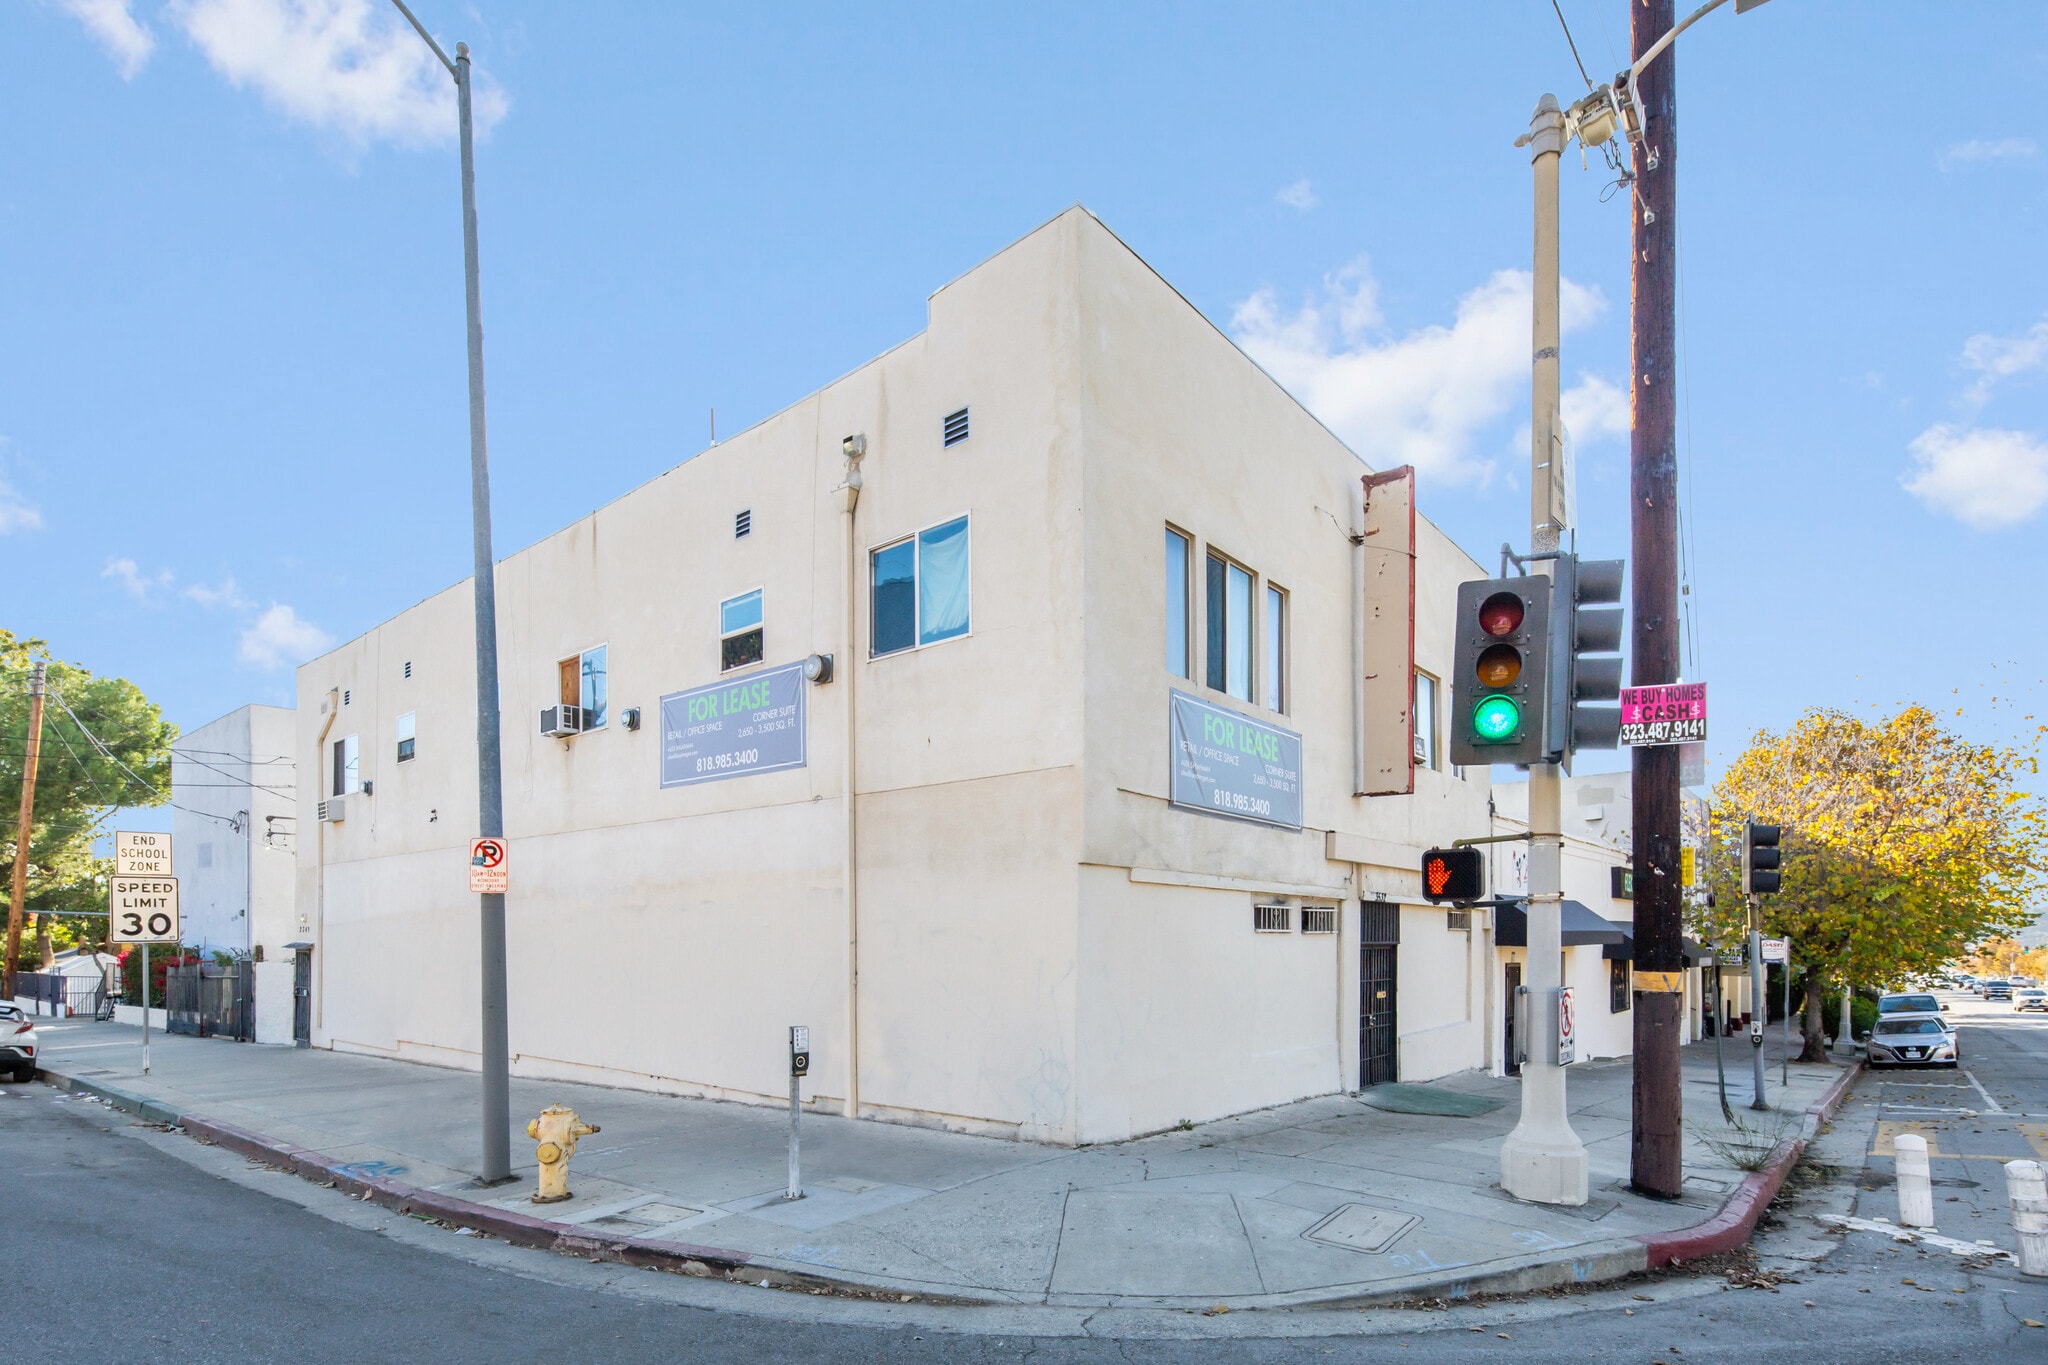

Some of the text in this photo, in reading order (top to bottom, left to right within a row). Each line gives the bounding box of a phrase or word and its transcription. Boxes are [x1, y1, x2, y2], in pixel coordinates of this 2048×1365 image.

[688, 681, 770, 723] FOR LEASE
[1623, 684, 1704, 705] WE BUY HOMES
[753, 705, 796, 722] CORNER SUITE
[1642, 703, 1690, 721] CASH
[667, 730, 682, 740] RETAIL
[687, 725, 705, 736] OFFICE
[706, 721, 723, 733] SPACE
[758, 722, 774, 735] 3,500
[1204, 713, 1278, 762] FOR LEASE
[1622, 718, 1704, 740] 323.487.9141
[696, 748, 758, 772] 818.985.3400
[1180, 740, 1198, 754] RETAIL
[1203, 746, 1222, 761] OFFICE
[1223, 752, 1239, 767] SPACE
[1265, 764, 1296, 781] CORNER SUITE
[1214, 789, 1270, 815] 818.985.3400
[133, 836, 155, 846] END
[121, 848, 168, 859] SCHOOL
[129, 861, 160, 871] ZONE
[117, 882, 173, 893] SPEED
[123, 898, 167, 908] LIMIT
[120, 912, 172, 936] 30
